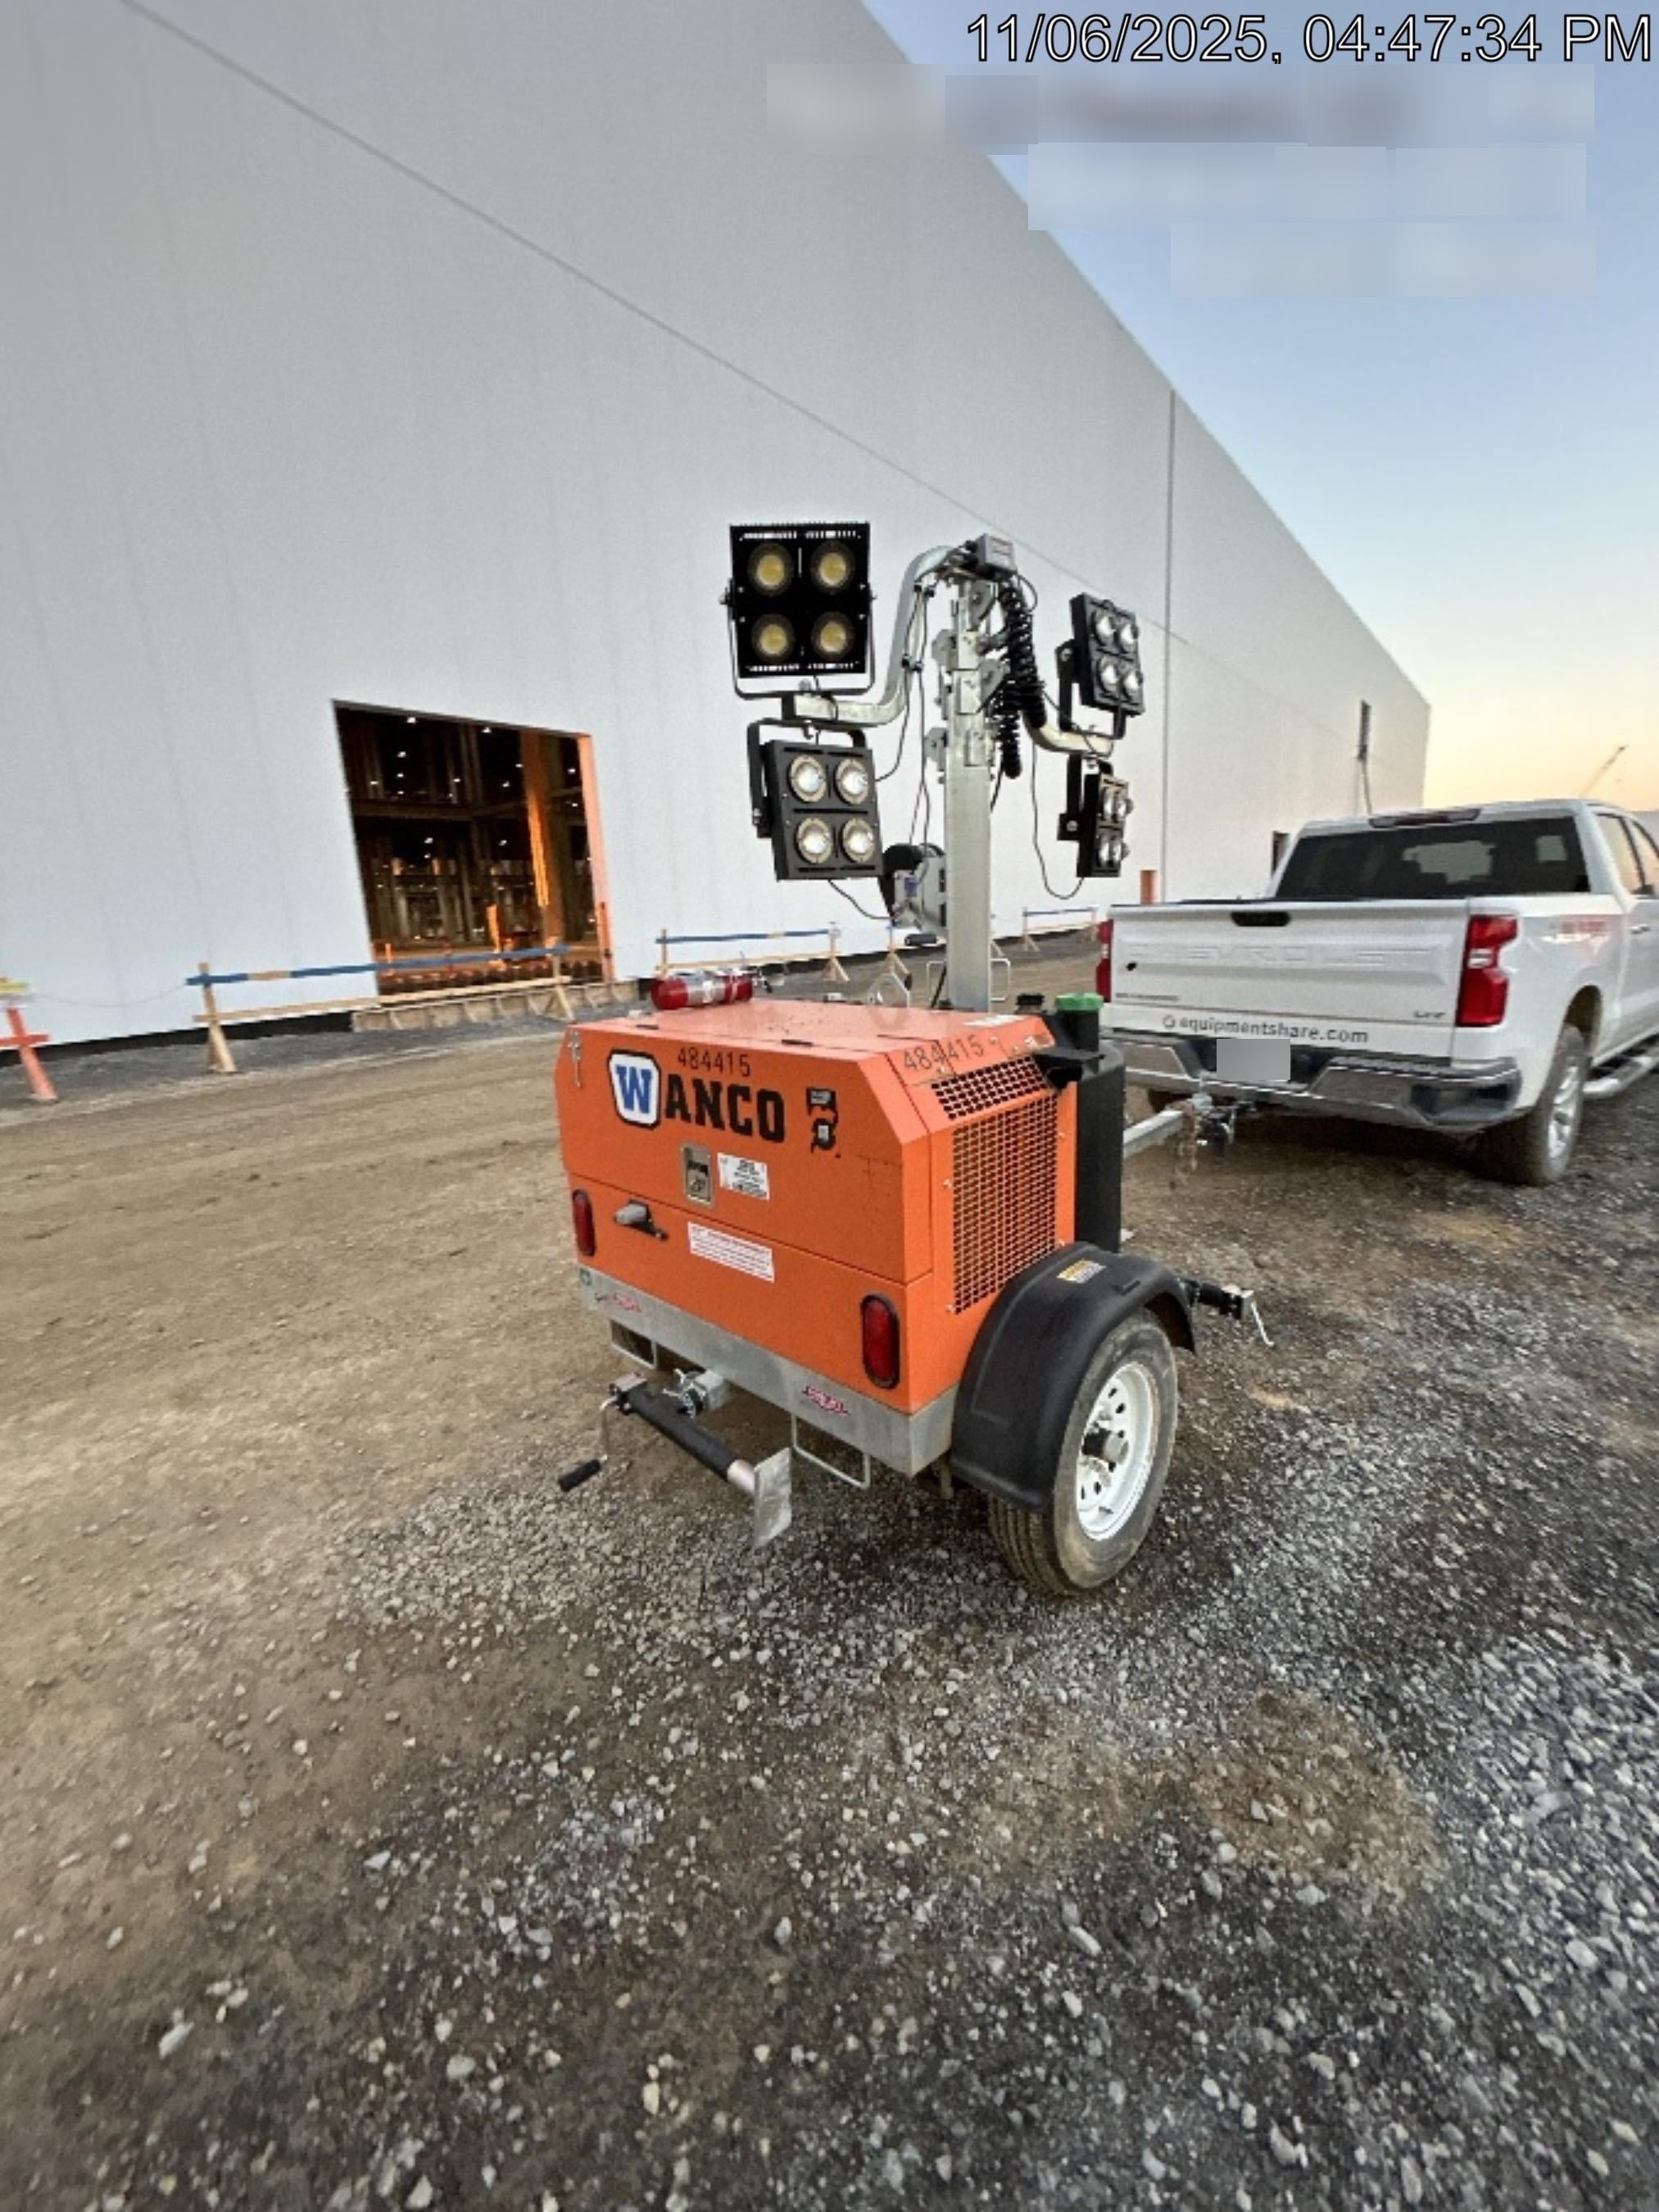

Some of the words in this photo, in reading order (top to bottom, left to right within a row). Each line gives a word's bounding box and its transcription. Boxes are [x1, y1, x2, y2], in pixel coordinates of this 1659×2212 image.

[1179, 1016, 1369, 1044] equipmentshare.com
[677, 1045, 750, 1077] 484415
[903, 1034, 985, 1072] 484415
[613, 1063, 786, 1145] WANCO
